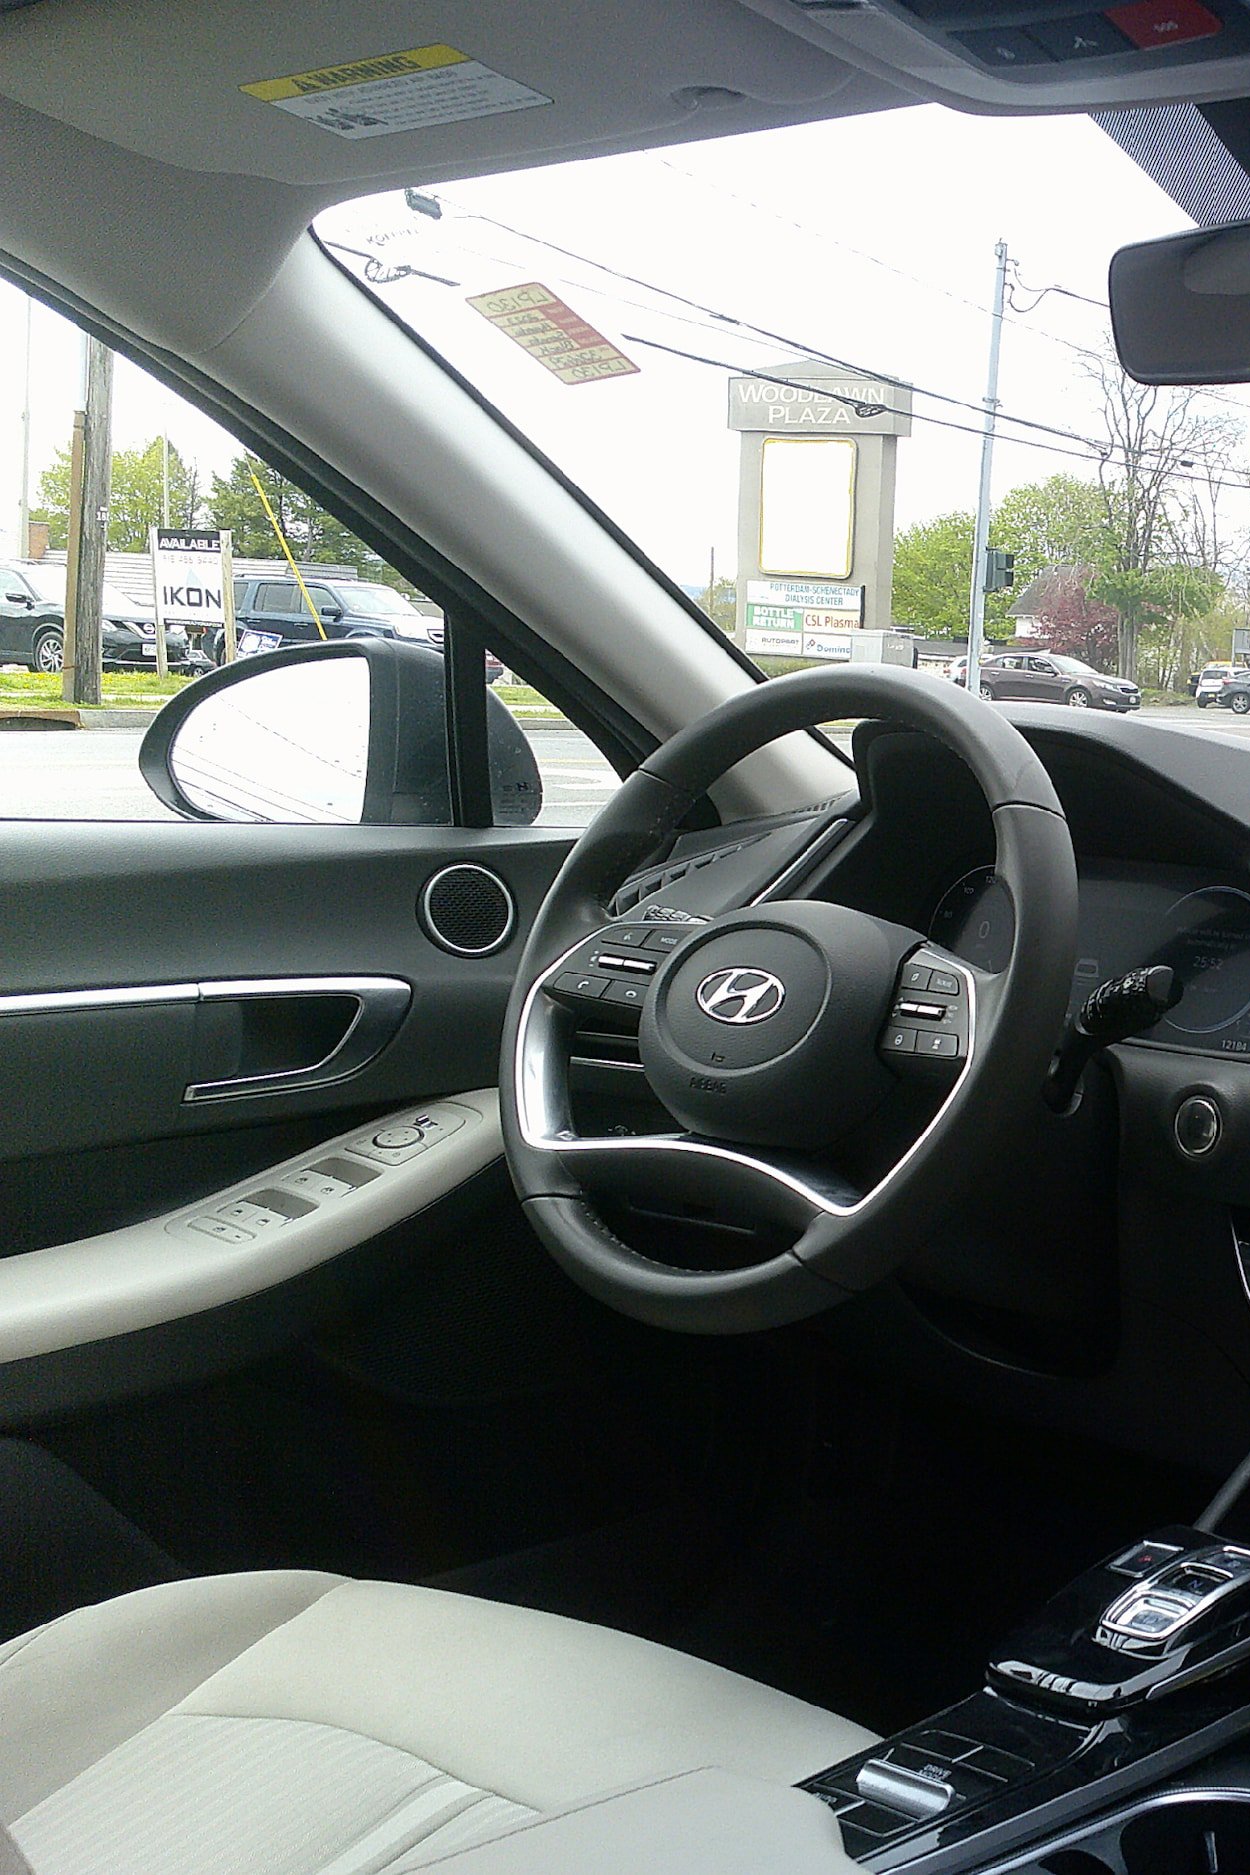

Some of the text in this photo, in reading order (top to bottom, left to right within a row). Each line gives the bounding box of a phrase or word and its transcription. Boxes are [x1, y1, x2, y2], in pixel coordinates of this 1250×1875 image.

[316, 55, 421, 85] WARNING
[738, 383, 885, 403] WOODLAWN
[768, 406, 851, 424] PLAZA
[159, 537, 221, 551] AVAILABLE
[163, 586, 222, 609] IKON
[785, 595, 844, 606] DIALYSIS CENTER
[753, 605, 795, 618] BOTTLE
[752, 616, 796, 629] RETURN
[805, 614, 860, 629] CSL Plasma
[979, 920, 990, 939] 0
[660, 937, 678, 945] MODE
